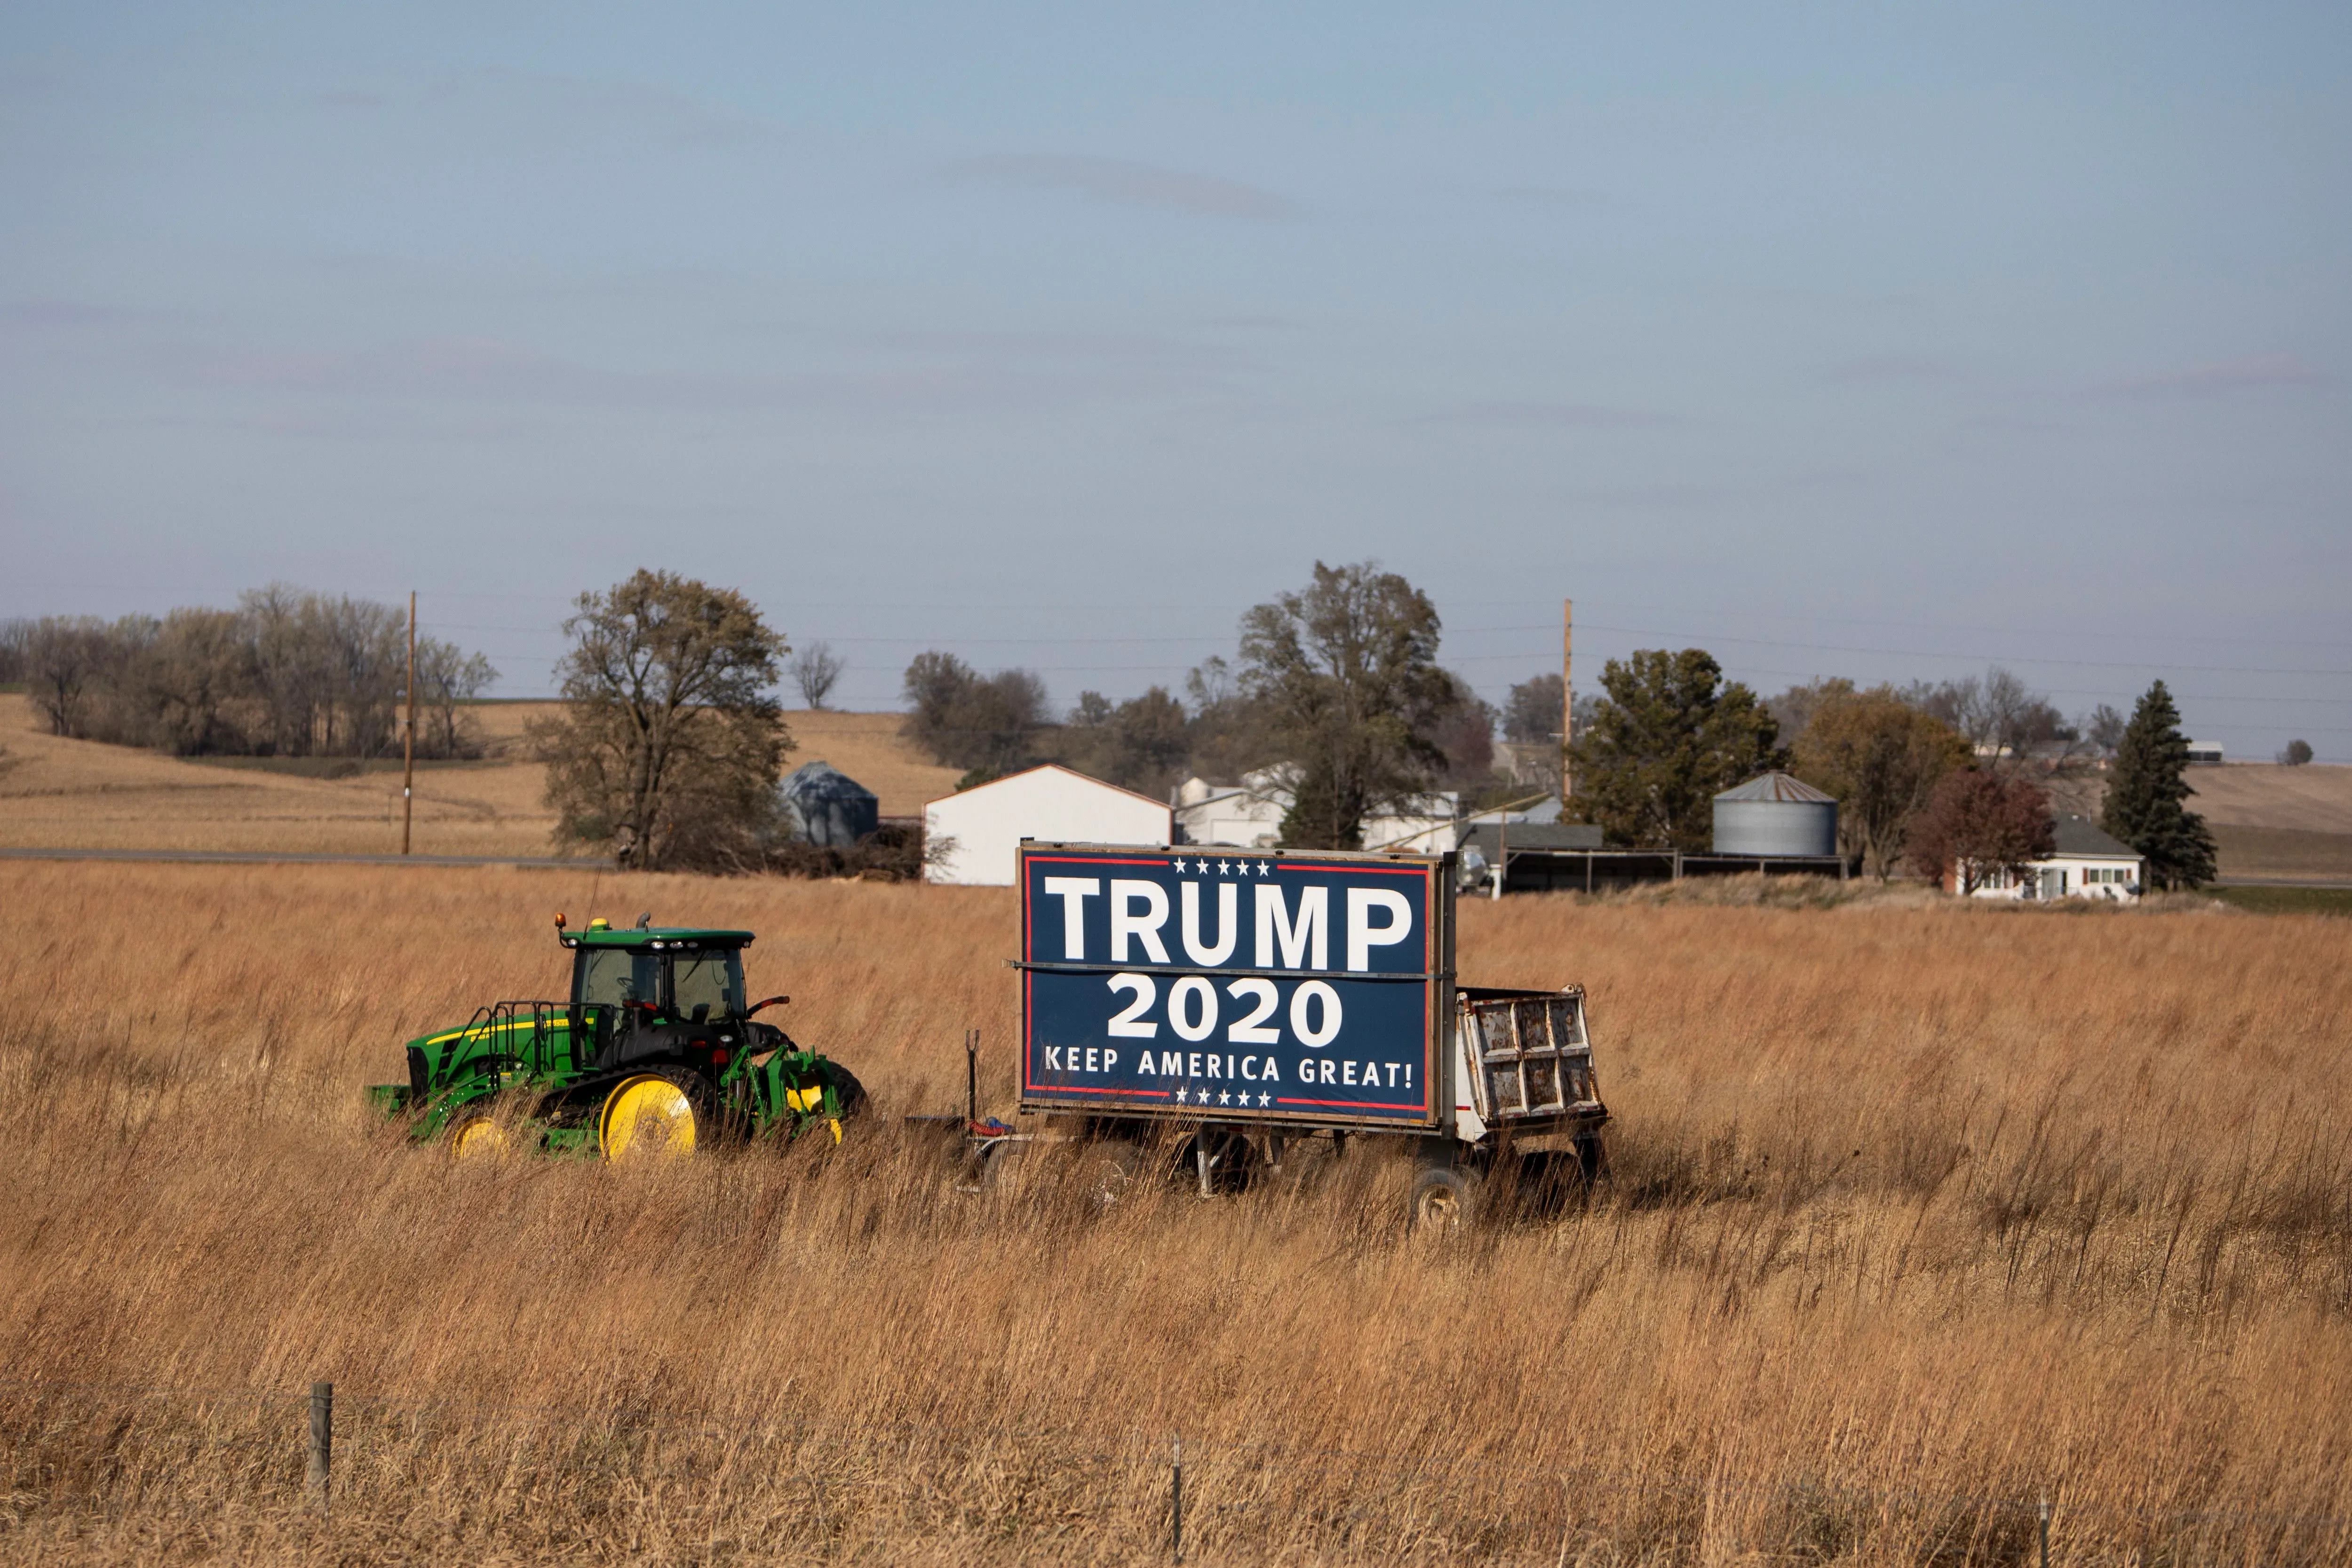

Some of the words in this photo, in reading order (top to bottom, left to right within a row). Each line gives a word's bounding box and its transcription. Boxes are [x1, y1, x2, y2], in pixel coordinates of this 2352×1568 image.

[1045, 876, 1412, 972] TRUMP
[1107, 972, 1343, 1048] 2020
[1045, 1046, 1118, 1073] KEEP
[1137, 1050, 1279, 1082] AMERICA
[1299, 1059, 1412, 1089] GREAT!
